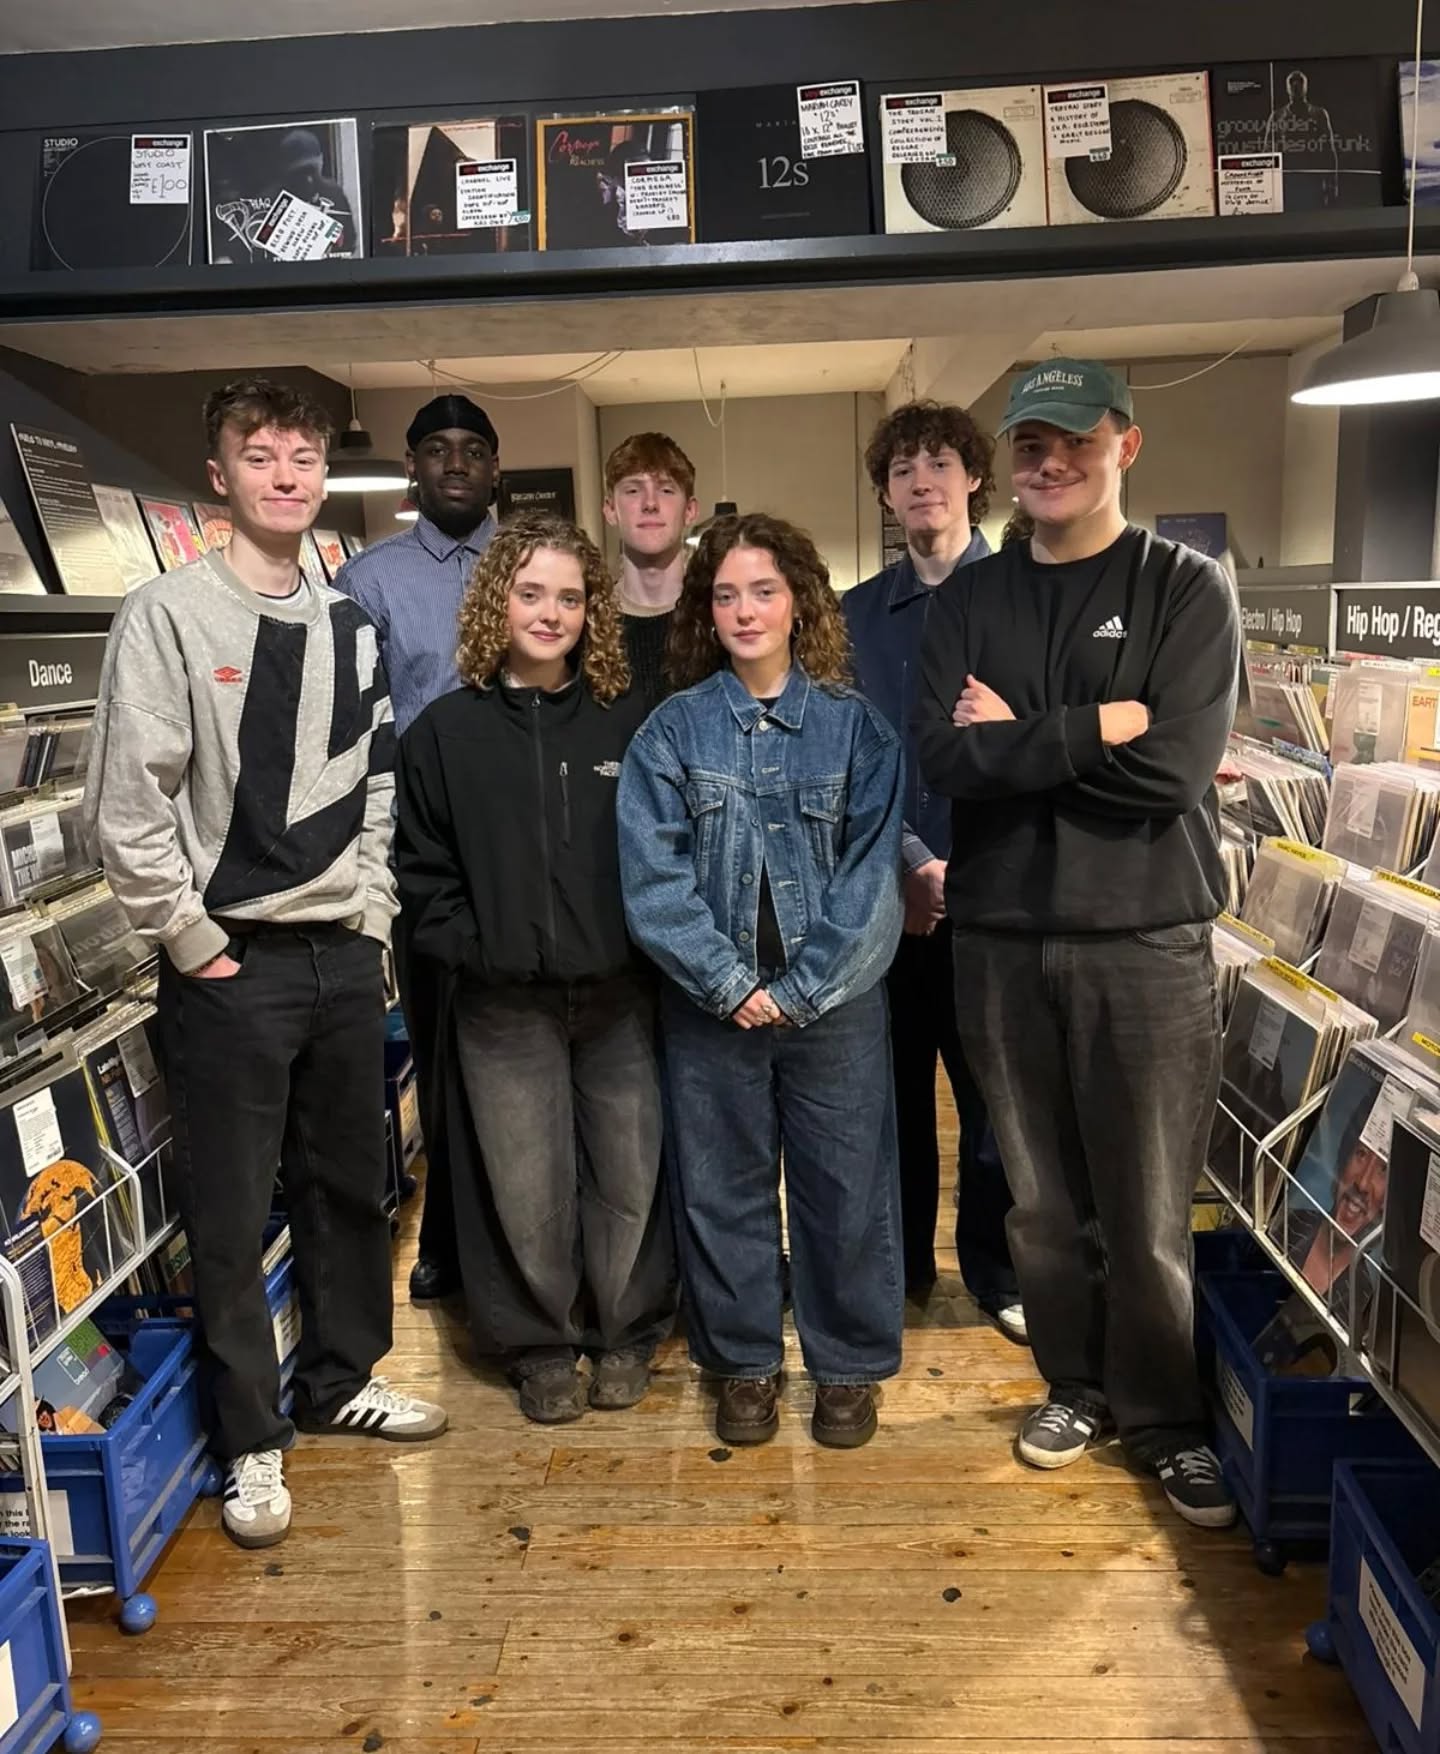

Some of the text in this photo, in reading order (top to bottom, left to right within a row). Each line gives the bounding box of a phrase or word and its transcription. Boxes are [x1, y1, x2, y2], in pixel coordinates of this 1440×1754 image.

[830, 98, 853, 108] CAREY
[44, 138, 78, 148] STUDIO
[758, 156, 809, 188] 12s
[1241, 607, 1265, 630] Electro
[1272, 608, 1284, 637] Hip
[1286, 608, 1302, 638] Hop
[1346, 605, 1369, 642] Hip
[1371, 605, 1400, 644] Hop
[1401, 605, 1411, 638] /
[1092, 629, 1128, 638] adidas
[28, 659, 73, 688] Dance
[5, 1520, 20, 1528] the
